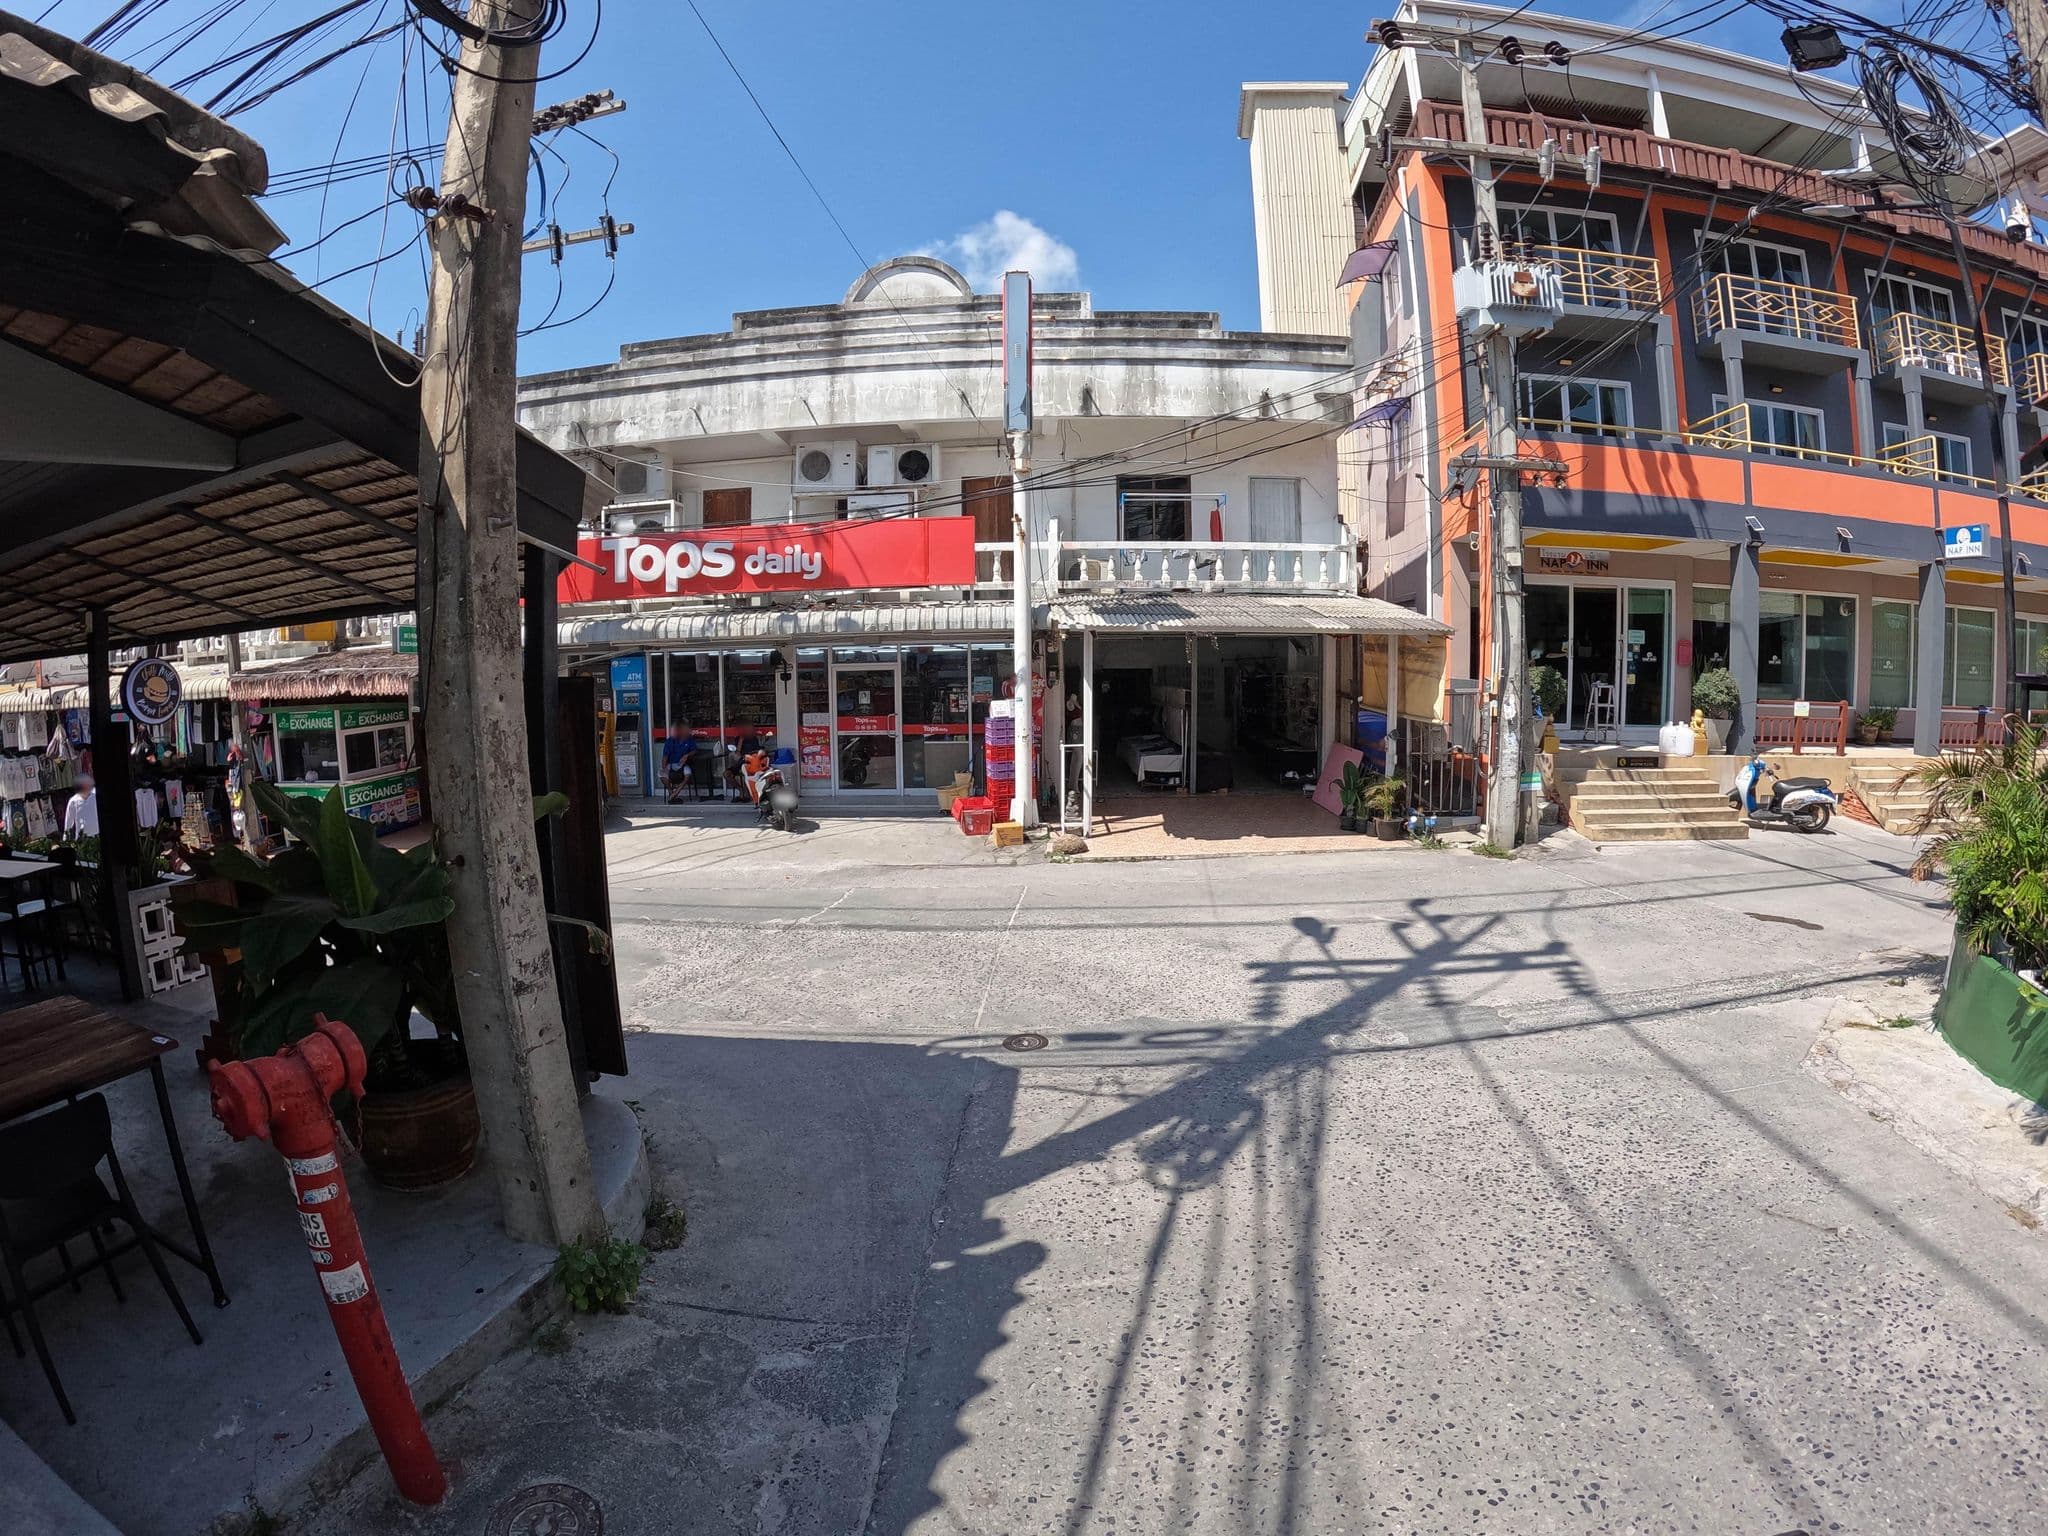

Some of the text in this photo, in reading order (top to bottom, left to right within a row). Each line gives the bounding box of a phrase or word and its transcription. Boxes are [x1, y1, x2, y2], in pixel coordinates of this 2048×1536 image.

[1948, 545, 1981, 555] NAP INN
[601, 536, 822, 593] Tops daily
[1541, 558, 1609, 570] NAP INN
[627, 672, 642, 680] ATM
[290, 718, 334, 730] EXCHANGE
[358, 711, 405, 725] EXCHANGE
[348, 783, 404, 805] EXCHANGE
